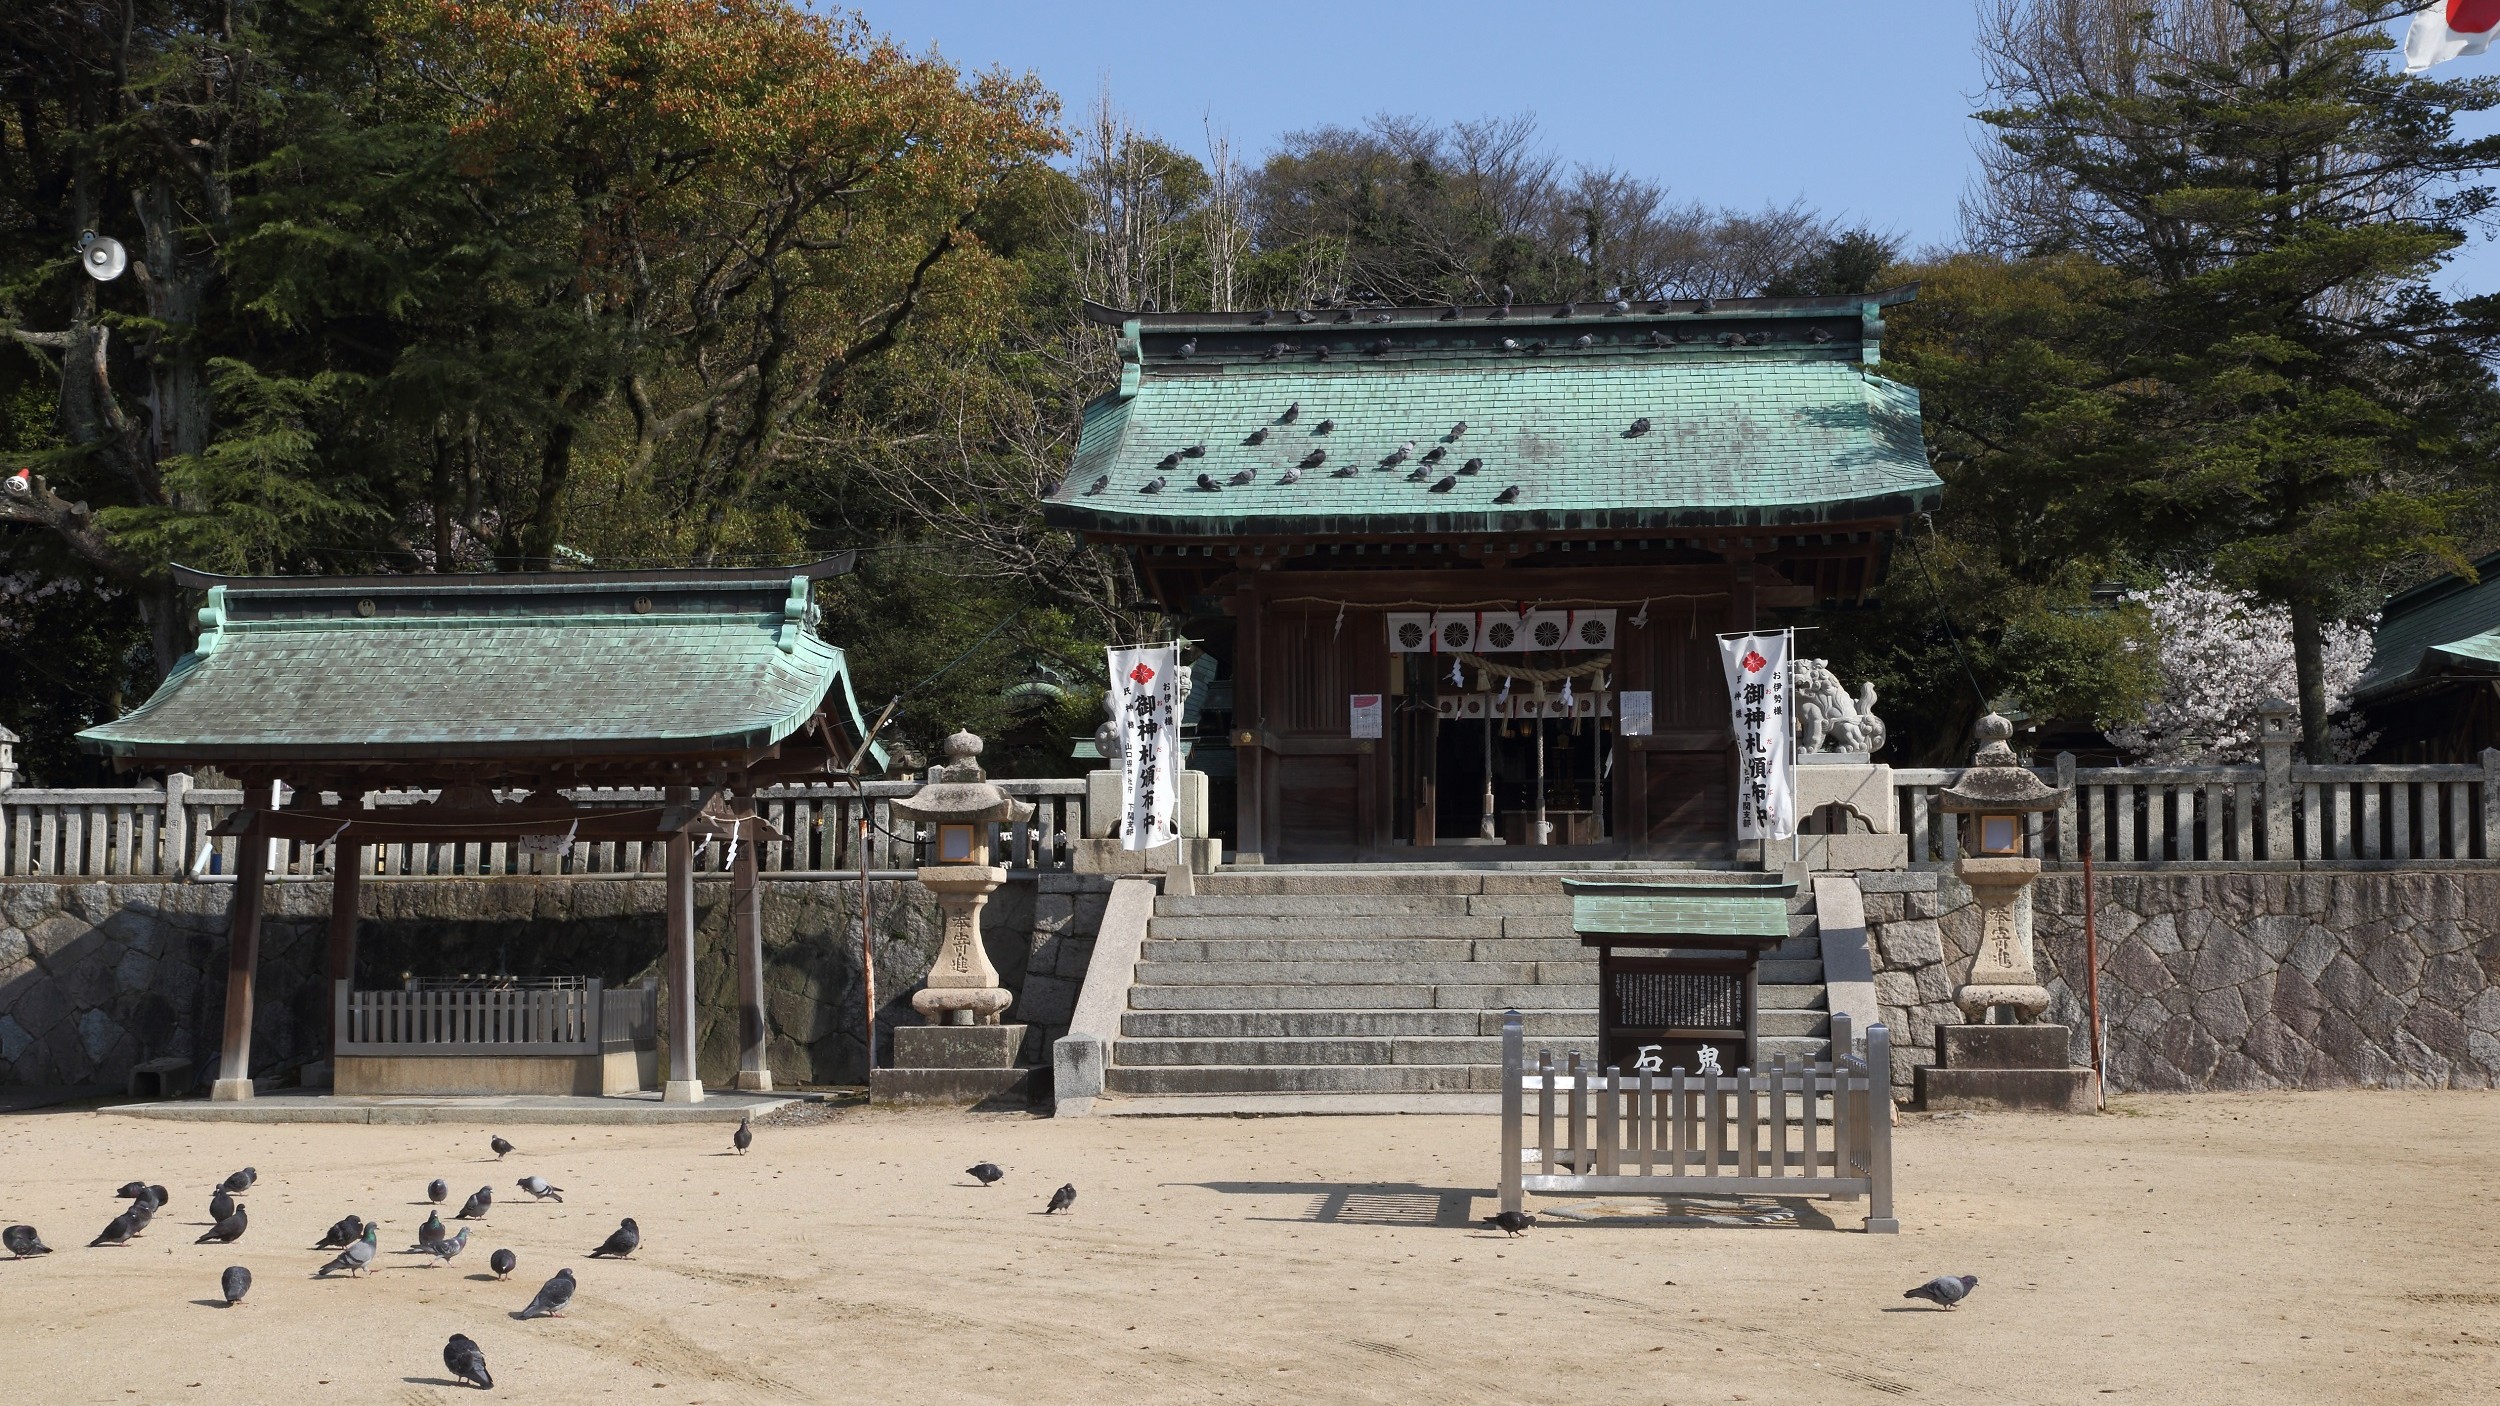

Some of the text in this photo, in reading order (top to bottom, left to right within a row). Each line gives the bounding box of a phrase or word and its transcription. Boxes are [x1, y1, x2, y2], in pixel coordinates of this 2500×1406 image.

[1163, 683, 1173, 726] お伊勢様
[1773, 672, 1783, 715] お伊勢様
[1134, 694, 1158, 835] 御神札頒布中
